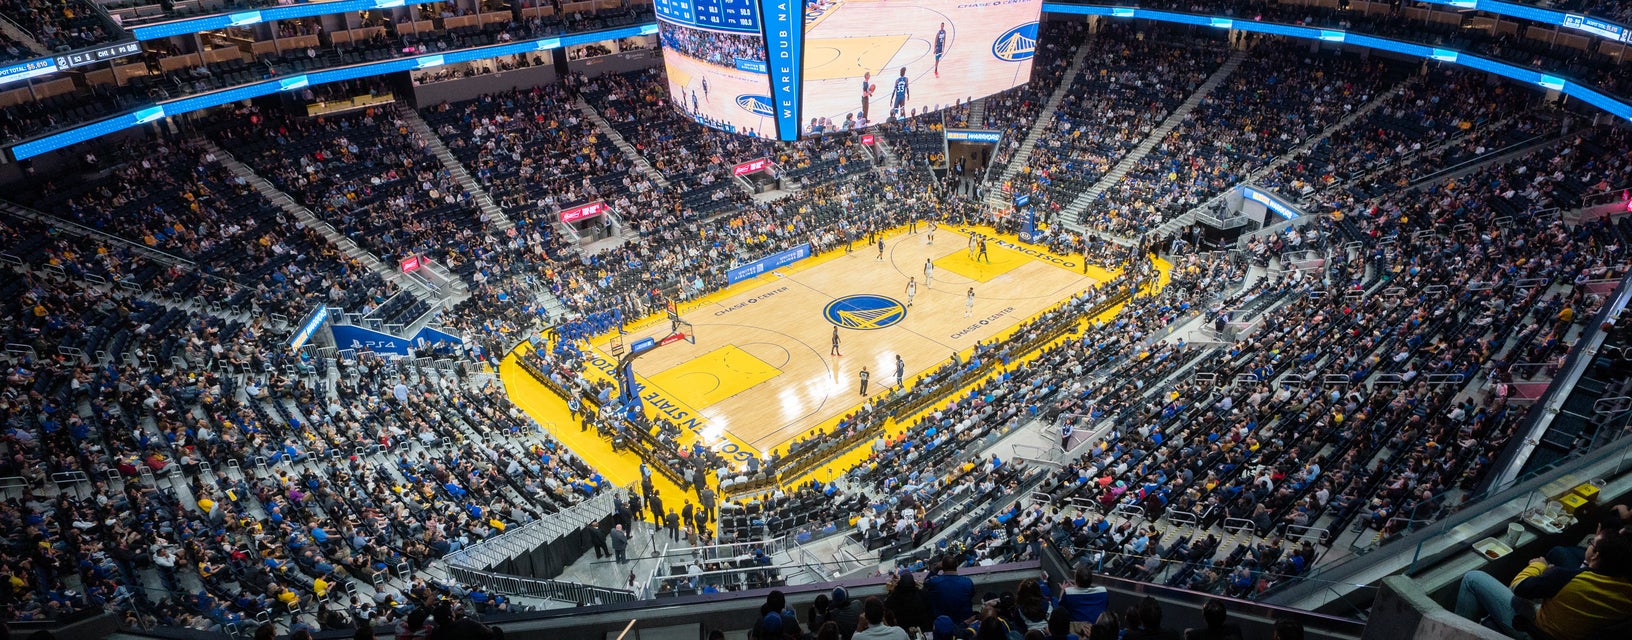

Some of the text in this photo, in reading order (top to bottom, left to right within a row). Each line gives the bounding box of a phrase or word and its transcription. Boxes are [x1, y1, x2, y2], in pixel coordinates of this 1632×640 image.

[778, 2, 792, 118] WE ARE DUB NA
[968, 133, 1000, 141] WARRIORS
[780, 252, 796, 261] UNITED
[987, 237, 1076, 268] FRANCISCO
[776, 255, 797, 266] AIRLINES
[734, 270, 756, 281] AIRLINES
[738, 266, 756, 276] UNITED
[714, 286, 789, 317] CHASE CENTER
[950, 306, 1016, 339] CHASE CENTER
[365, 340, 397, 348] PS4
[642, 391, 689, 420] STATE
